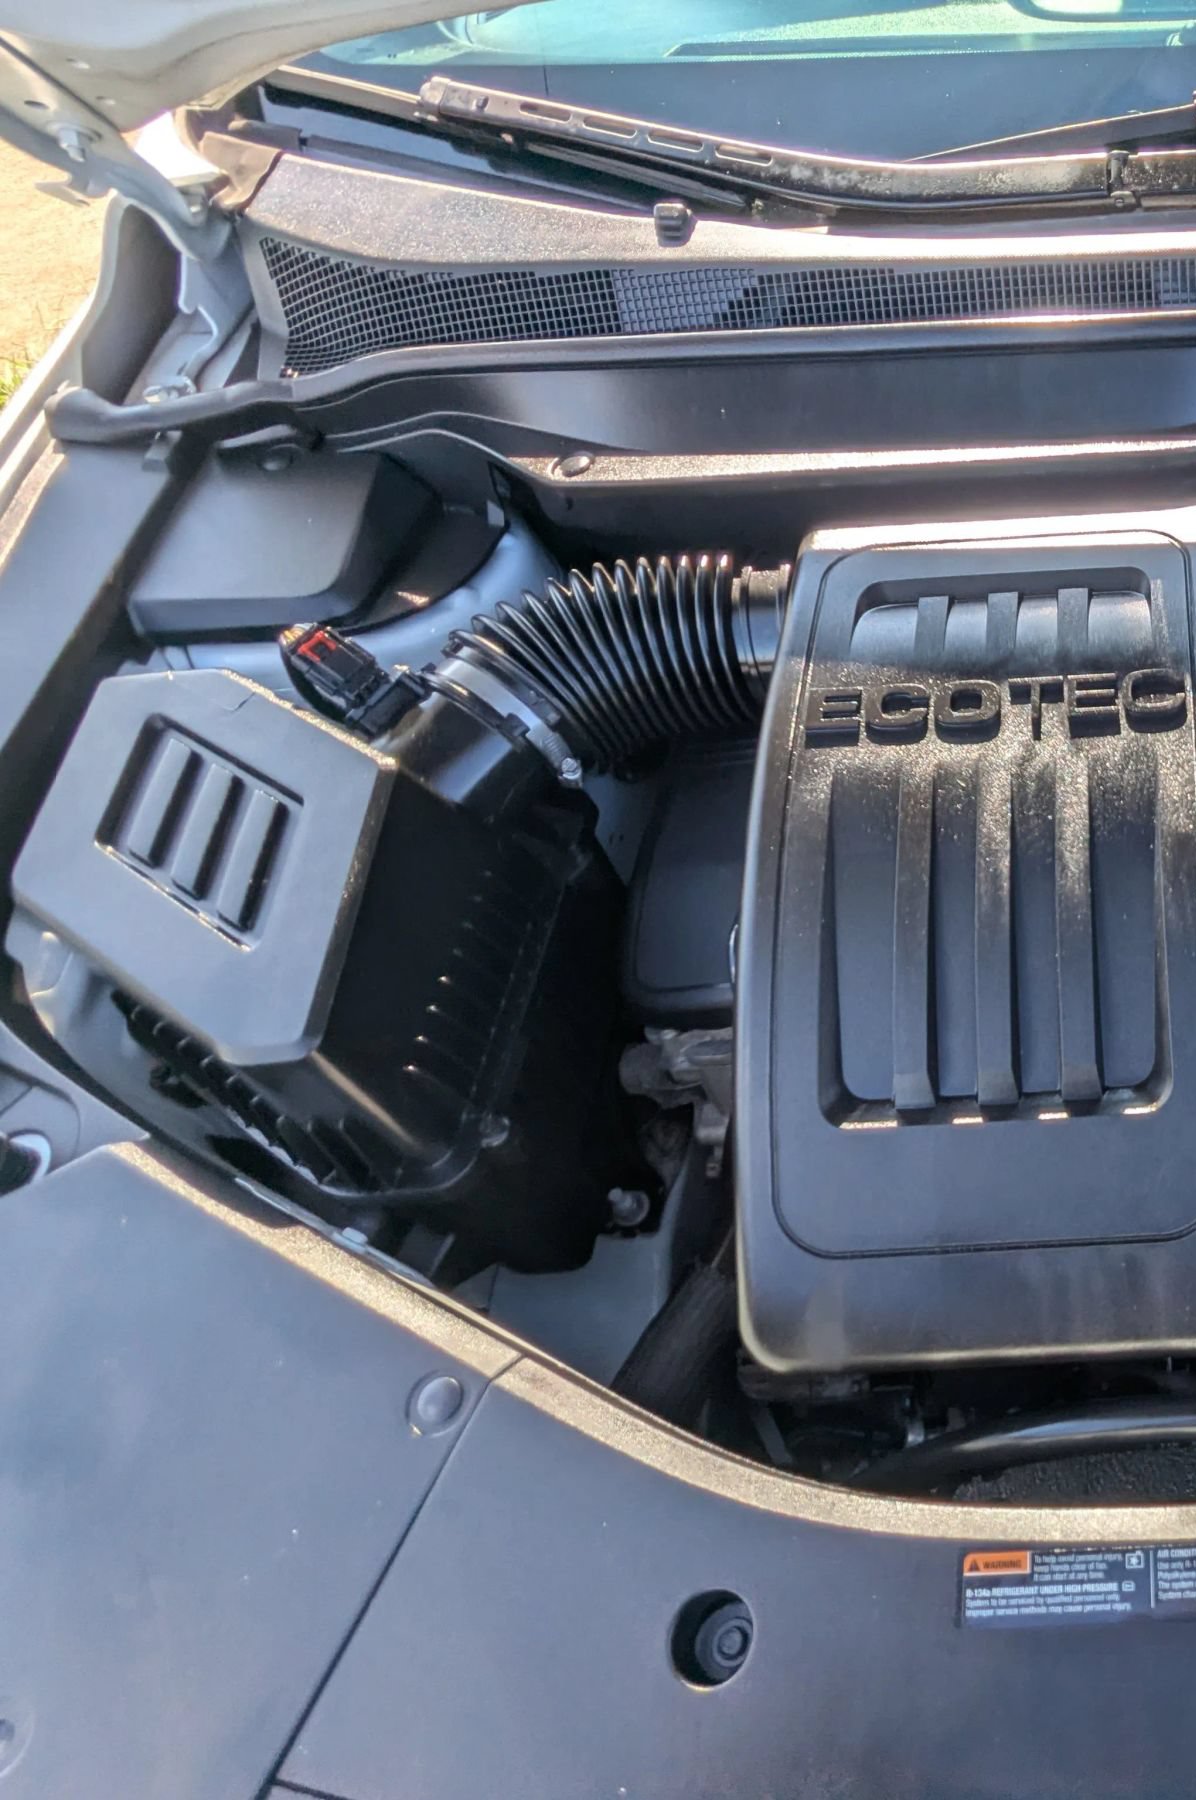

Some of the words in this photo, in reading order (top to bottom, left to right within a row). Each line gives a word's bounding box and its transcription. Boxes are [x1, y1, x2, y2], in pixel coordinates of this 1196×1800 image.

[806, 668, 1187, 747] ECOTEC
[1157, 1550, 1169, 1558] AIR
[983, 1559, 1022, 1569] WARNING
[992, 1586, 1038, 1596] REFRIGERANT
[1040, 1584, 1062, 1594] UNDER
[1065, 1584, 1080, 1592] HIGH
[1083, 1583, 1118, 1592] PRESSURE
